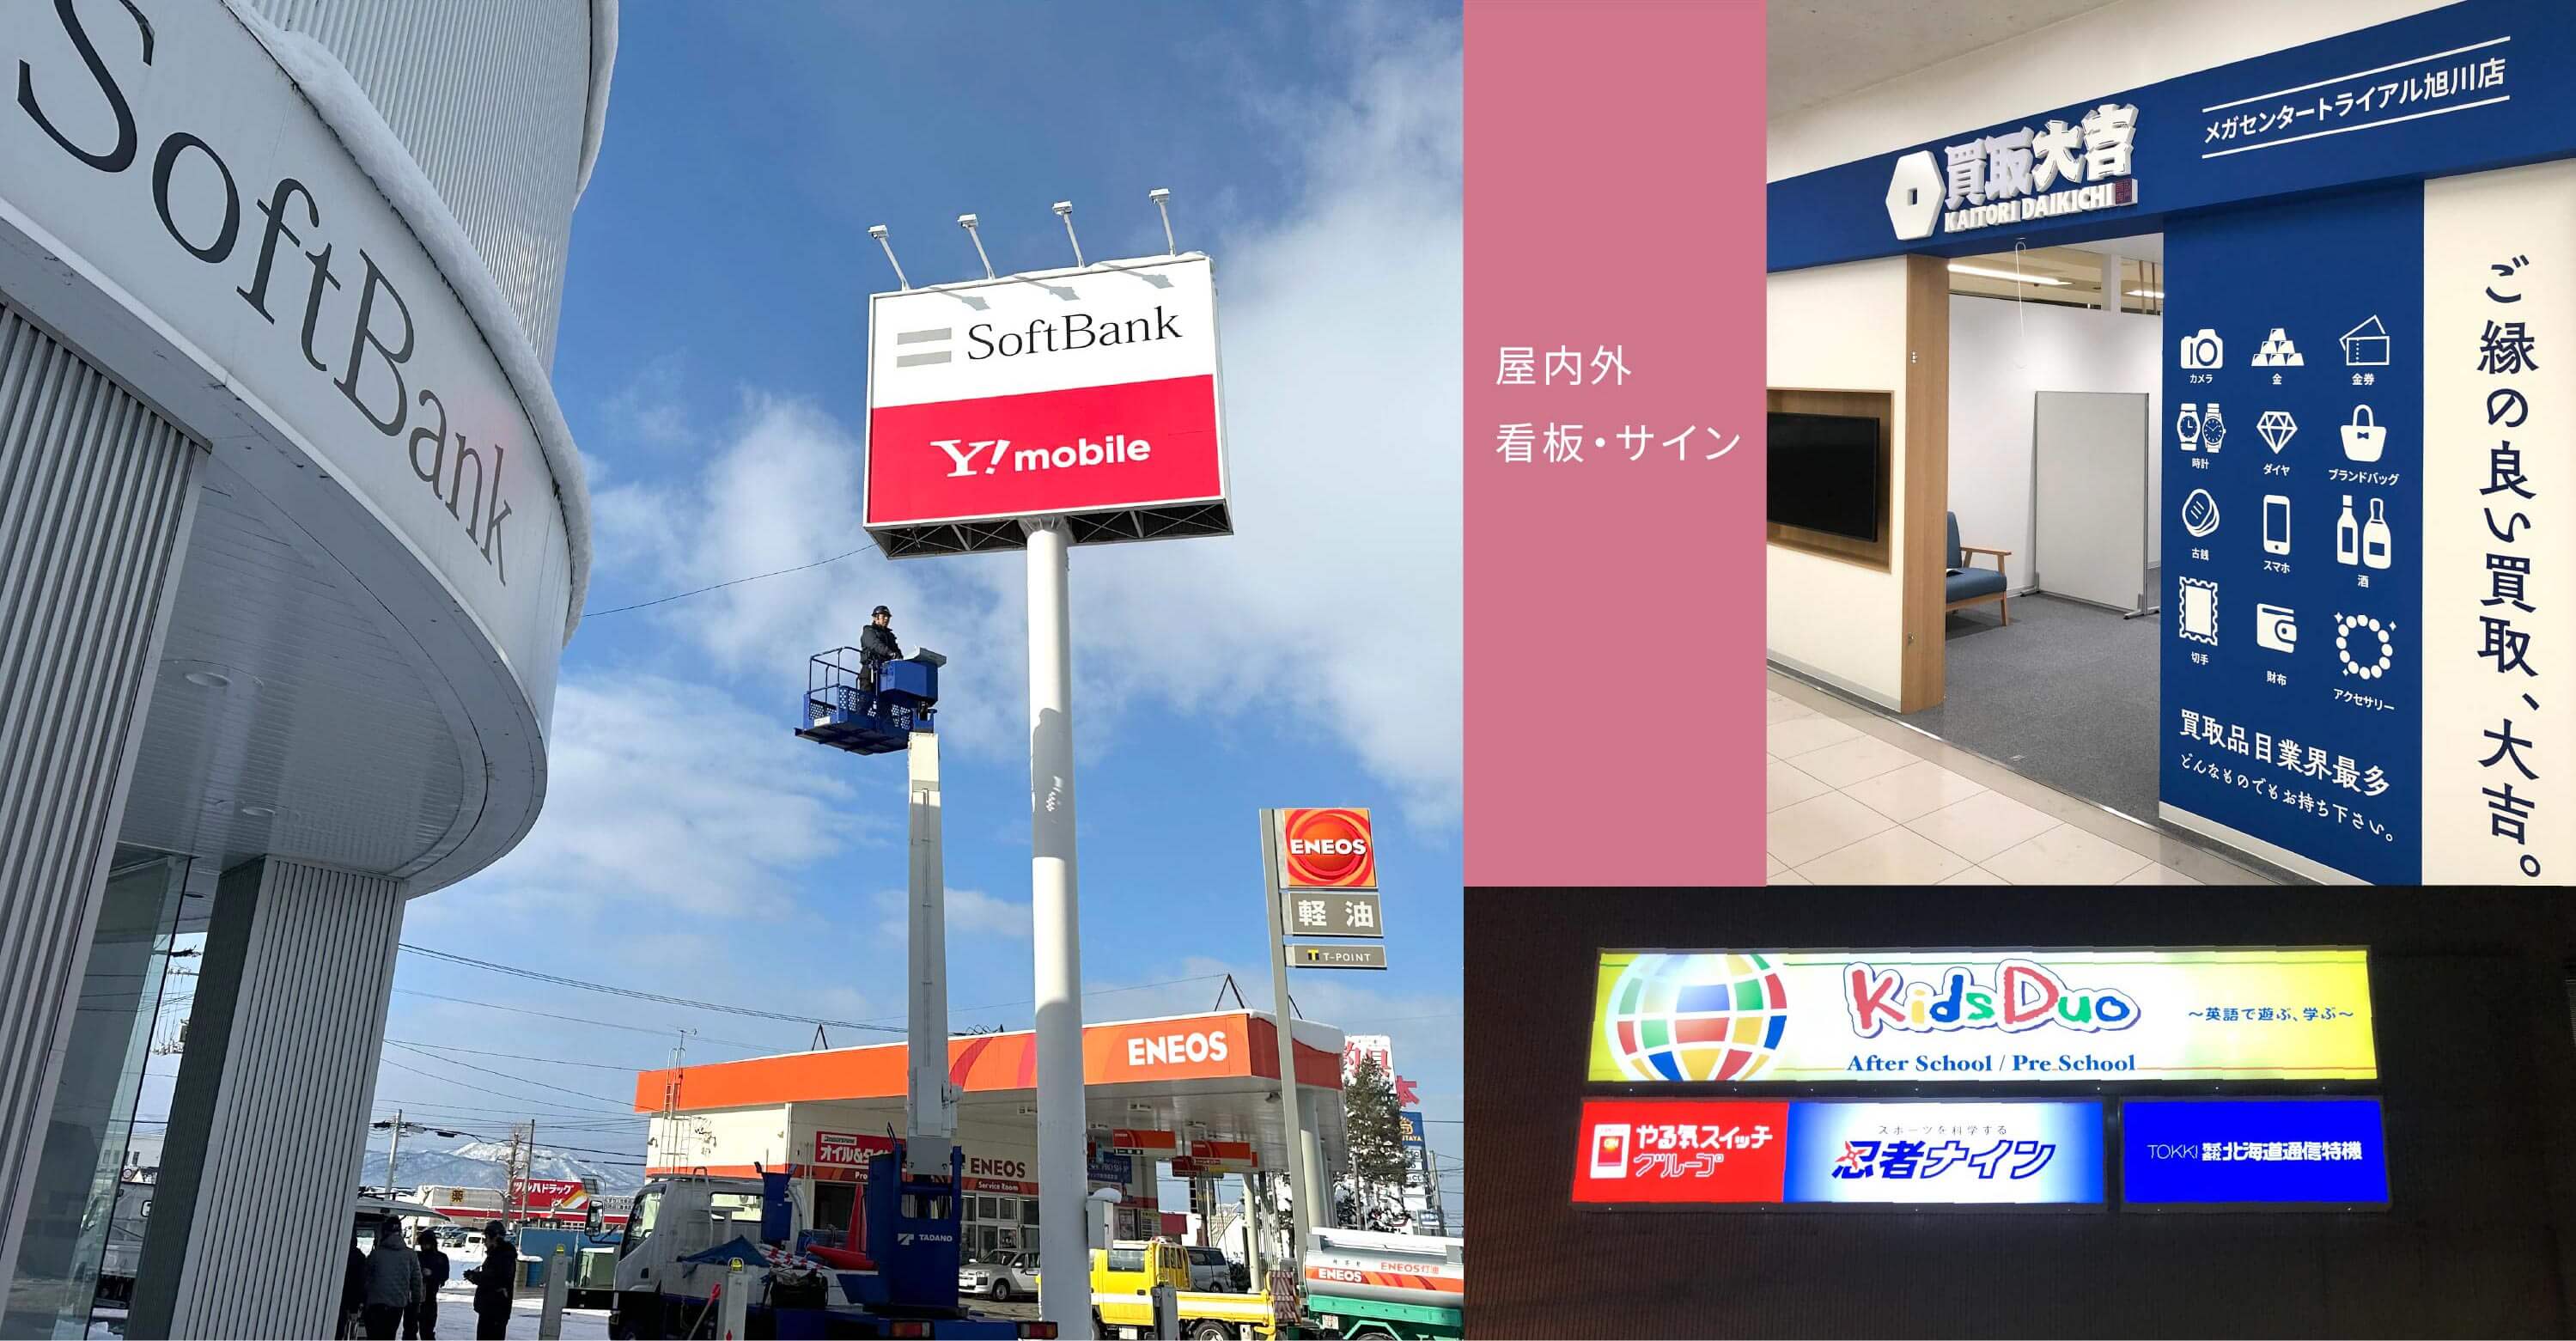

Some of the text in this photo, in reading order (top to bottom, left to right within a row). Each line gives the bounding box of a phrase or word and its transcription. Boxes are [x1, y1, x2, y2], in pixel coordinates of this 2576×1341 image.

[2204, 58, 2506, 143] メガセンタートライアル旭川店
[1944, 103, 2140, 210] 買取大吉
[1945, 200, 2021, 233] KAITORI
[2021, 182, 2116, 221] DAIKICHI
[18, 0, 512, 587] SoftBank
[967, 305, 1183, 361] SoftBank
[2189, 374, 2214, 384] カメラ
[2272, 374, 2282, 385] 金
[2352, 374, 2375, 386] 金券
[2191, 458, 2210, 469] 時計
[2262, 464, 2291, 476] ダイヤ
[2329, 469, 2400, 486] ブランドバッグ
[2191, 547, 2210, 561] 古銭
[2263, 560, 2291, 573] スマホ
[2476, 253, 2543, 878] ご縁の良い買取、大吉。
[2357, 575, 2369, 588] 酒
[2190, 651, 2209, 665] 切手
[2267, 670, 2287, 686] 財布
[2333, 688, 2396, 711] アクセサリー
[2180, 709, 2390, 797] 買取品目業界最多
[2180, 753, 2394, 843] どんなものでもお持ち下さい。
[1289, 838, 1367, 856] ENEOS
[1298, 899, 1374, 928] 軽油
[1323, 952, 1372, 963] T-POINT
[1127, 1031, 1228, 1066] ENEOS
[1847, 1055, 1909, 1072] After
[1915, 1054, 1993, 1072] School
[2013, 1055, 2051, 1072] Pre
[2058, 1054, 2136, 1072] School
[1635, 1124, 1774, 1150] やる気スイッチ
[1831, 1139, 2056, 1179] 忍者ナイン
[2147, 1143, 2198, 1160] TOKKI
[971, 1157, 1026, 1179] ENEOS
[1634, 1152, 1725, 1179] グループ
[978, 1181, 1019, 1191] Service Room
[918, 1234, 953, 1242] TADANO
[1318, 1267, 1362, 1283] ENEOS
